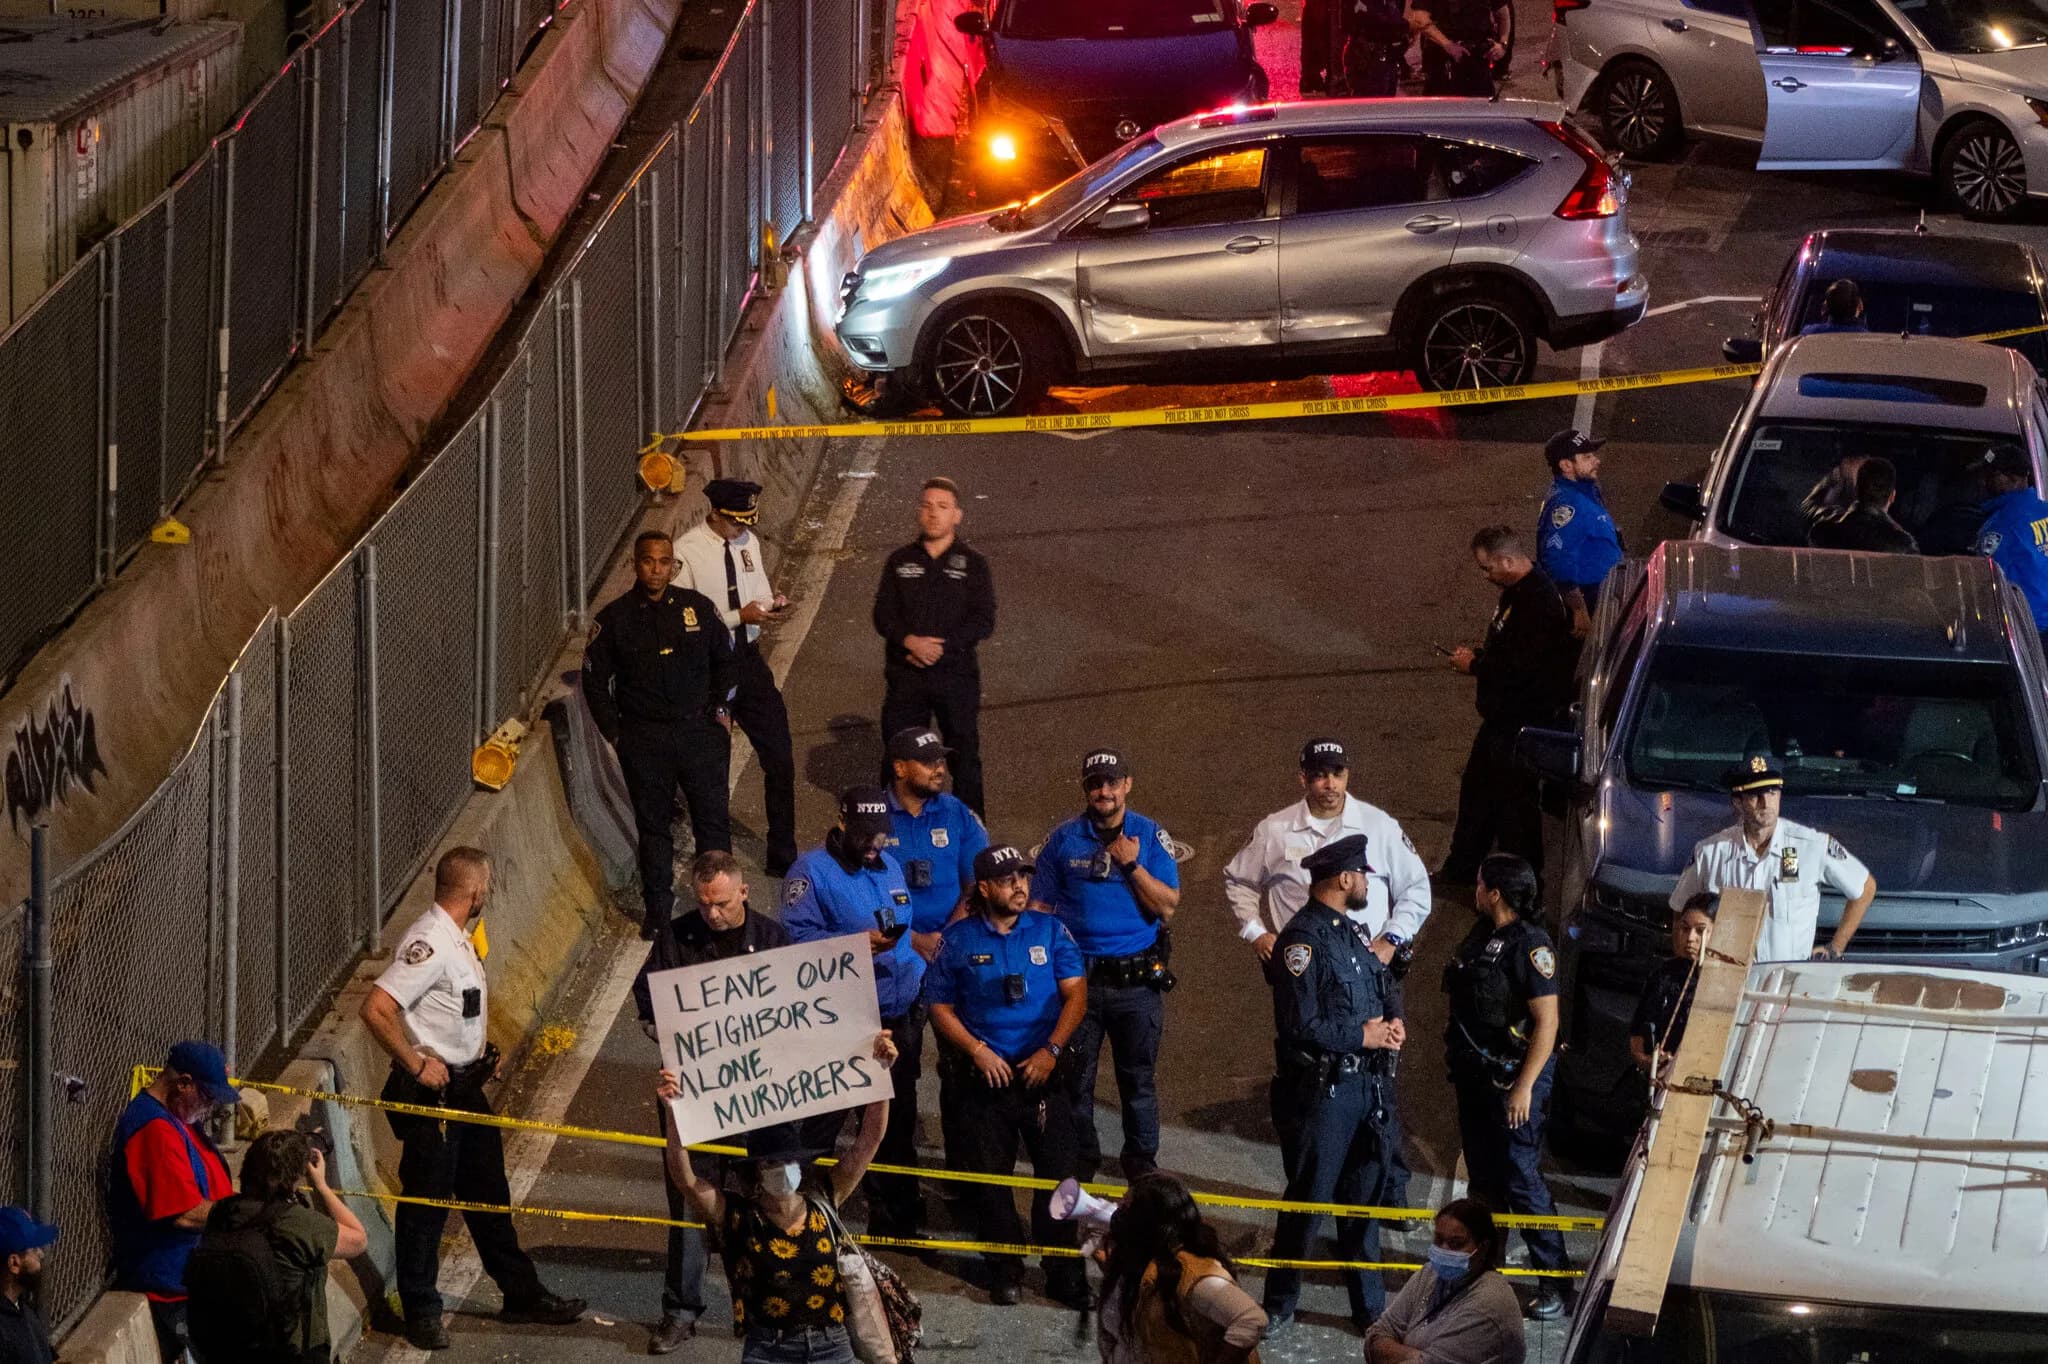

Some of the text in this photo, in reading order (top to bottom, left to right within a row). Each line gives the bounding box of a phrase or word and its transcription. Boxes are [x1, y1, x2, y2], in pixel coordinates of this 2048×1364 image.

[1576, 373, 1663, 392] POLICE LINE DO NOT CROSS
[1440, 386, 1526, 404] POLICE LINE DO NOT CROSS
[1302, 397, 1388, 414] POLICE LINE DO NOT CROSS
[1025, 414, 1112, 430] POLICE LINE DO NOT CROSS
[1164, 406, 1250, 423] POLICE LINE DO NOT CROSS
[740, 427, 829, 440] POLICE LINE DO NOT CROSS
[884, 421, 971, 436] POLICE LINE DO NOT CROSS
[915, 733, 939, 747] NYP
[1313, 742, 1343, 754] NYPD
[1085, 753, 1117, 768] NYPD
[857, 802, 887, 813] NYPD
[991, 847, 1024, 864] NYP
[673, 951, 860, 1013] LEAVE OUR
[673, 996, 839, 1066] NEIGHBORS
[679, 1048, 772, 1101] ALONE,
[713, 1055, 873, 1130] MURDERERS
